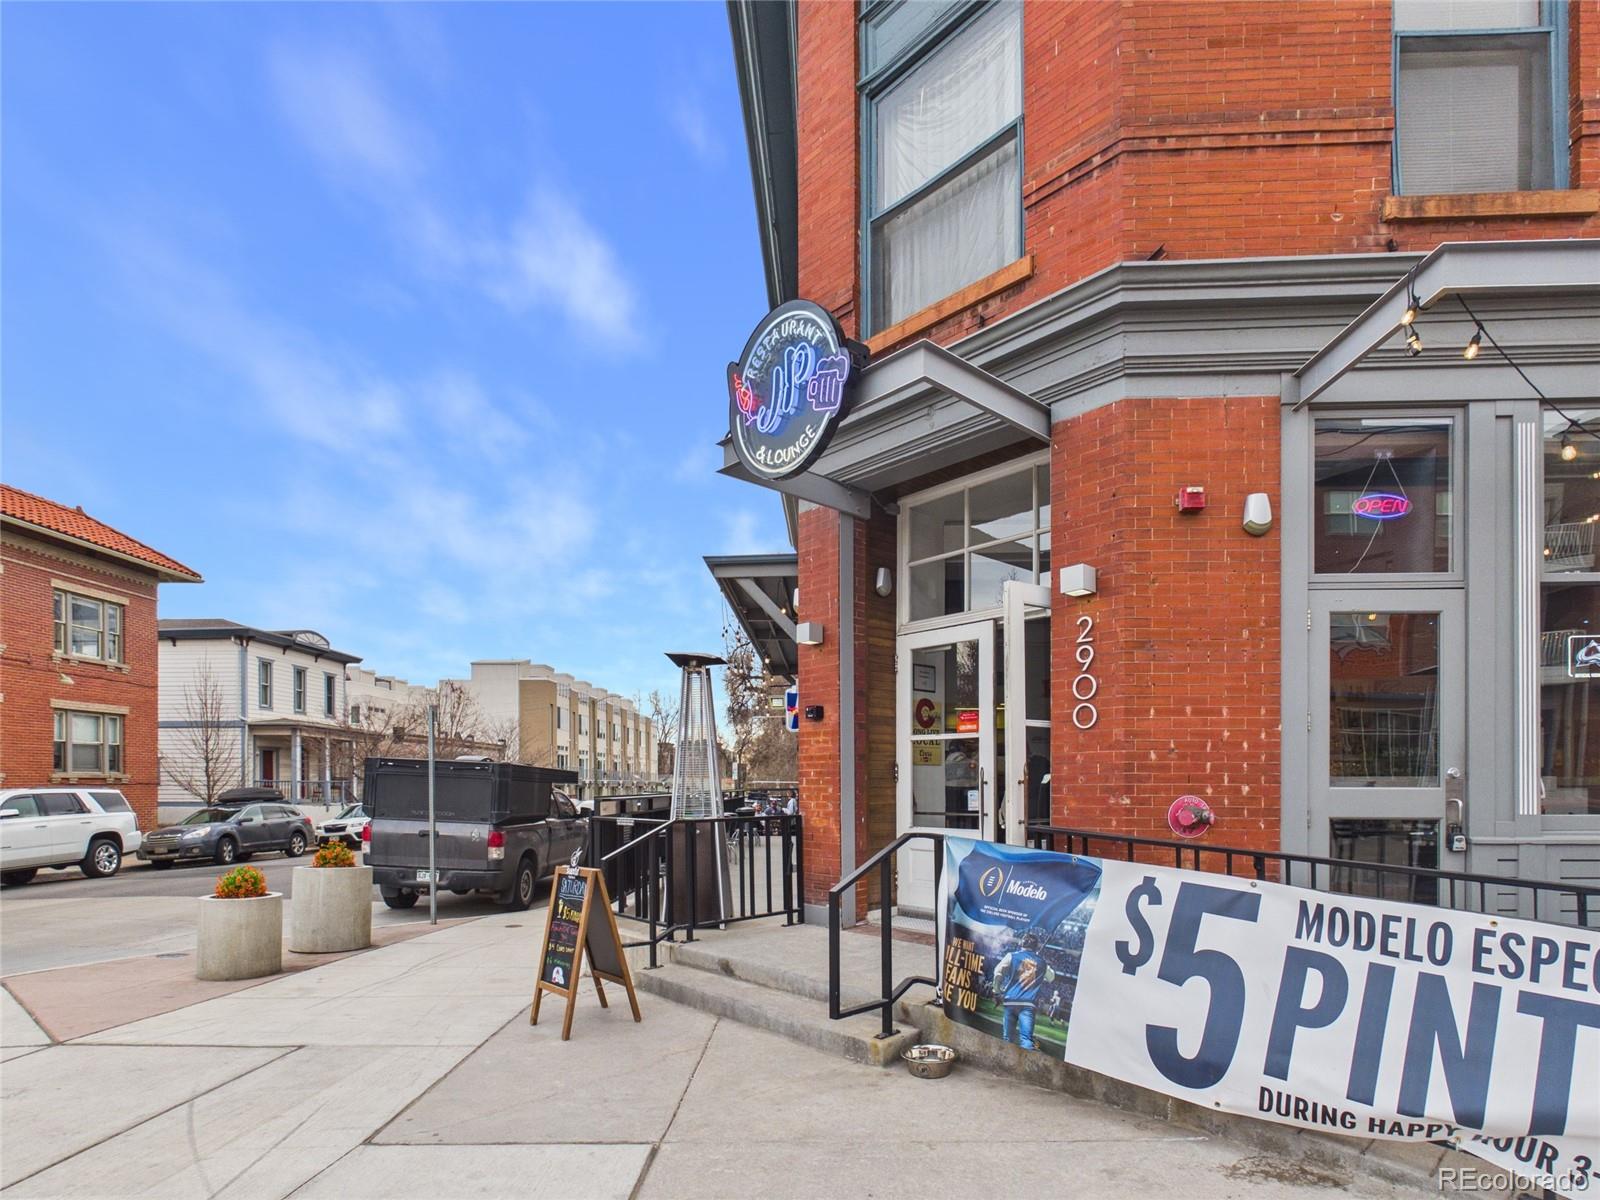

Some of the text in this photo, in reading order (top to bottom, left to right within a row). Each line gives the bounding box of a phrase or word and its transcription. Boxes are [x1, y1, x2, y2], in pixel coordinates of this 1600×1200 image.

[746, 320, 824, 379] RESTAURANT
[1355, 499, 1409, 513] OPEN
[1072, 615, 1098, 729] 2900
[1006, 879, 1048, 901] Modelo
[1294, 899, 1454, 966] MODELO
[945, 963, 972, 989] FANS
[956, 987, 978, 1012] YOU
[1114, 876, 1263, 1090] $5
[1263, 945, 1600, 1137] PINT
[1258, 1085, 1357, 1130] DURING
[1367, 1118, 1462, 1140] HAPPY
[1472, 1134, 1560, 1175] OUR
